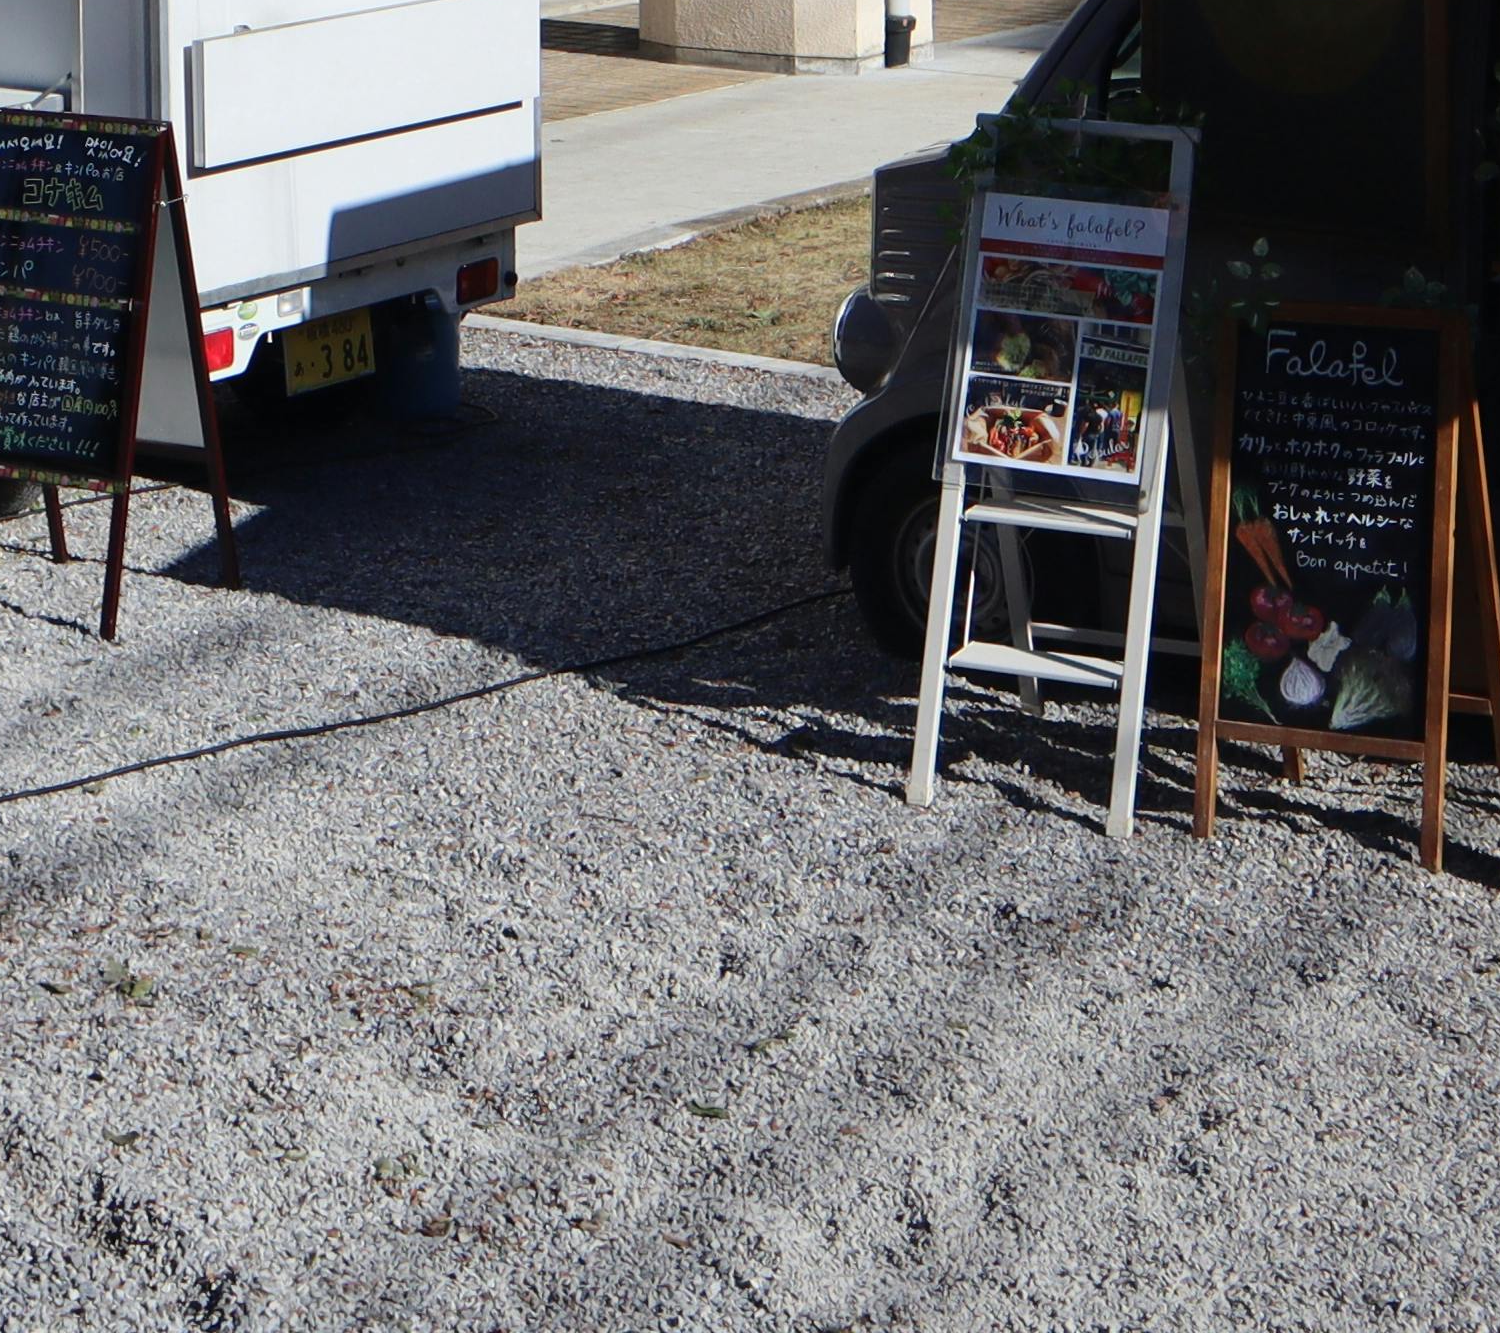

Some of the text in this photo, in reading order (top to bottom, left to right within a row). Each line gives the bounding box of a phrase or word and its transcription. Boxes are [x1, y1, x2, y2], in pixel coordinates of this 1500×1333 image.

[22, 177, 104, 212] コナキム
[998, 202, 1146, 243] What's falafel?
[1265, 328, 1405, 387] Falafel
[1296, 549, 1328, 569] Bon
